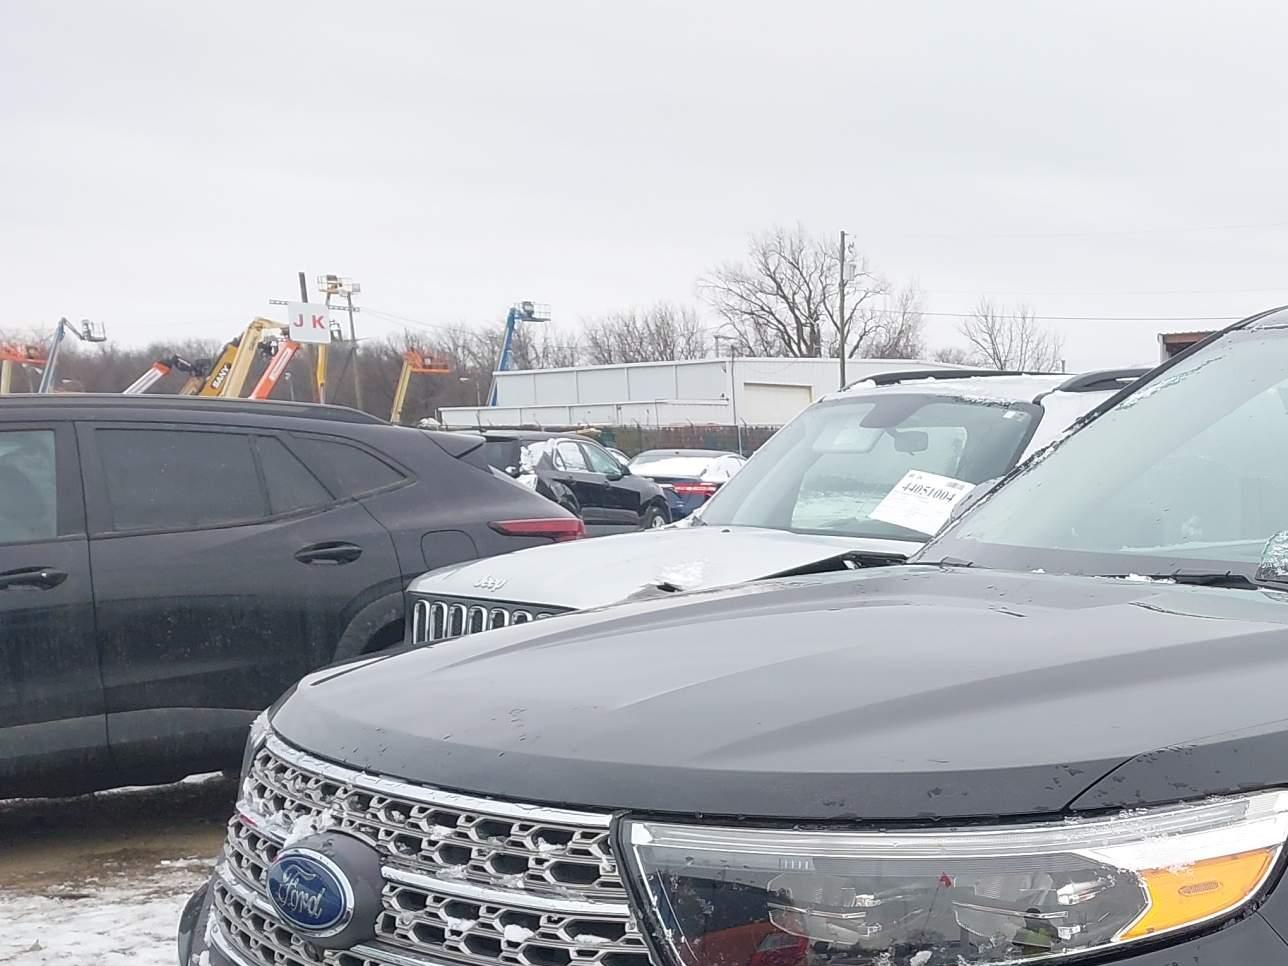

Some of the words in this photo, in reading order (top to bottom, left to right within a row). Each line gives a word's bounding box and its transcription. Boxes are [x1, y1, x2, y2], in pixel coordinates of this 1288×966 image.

[293, 313, 304, 328] J
[311, 314, 326, 329] K
[901, 481, 956, 502] 44051004
[278, 864, 327, 920] Ford
